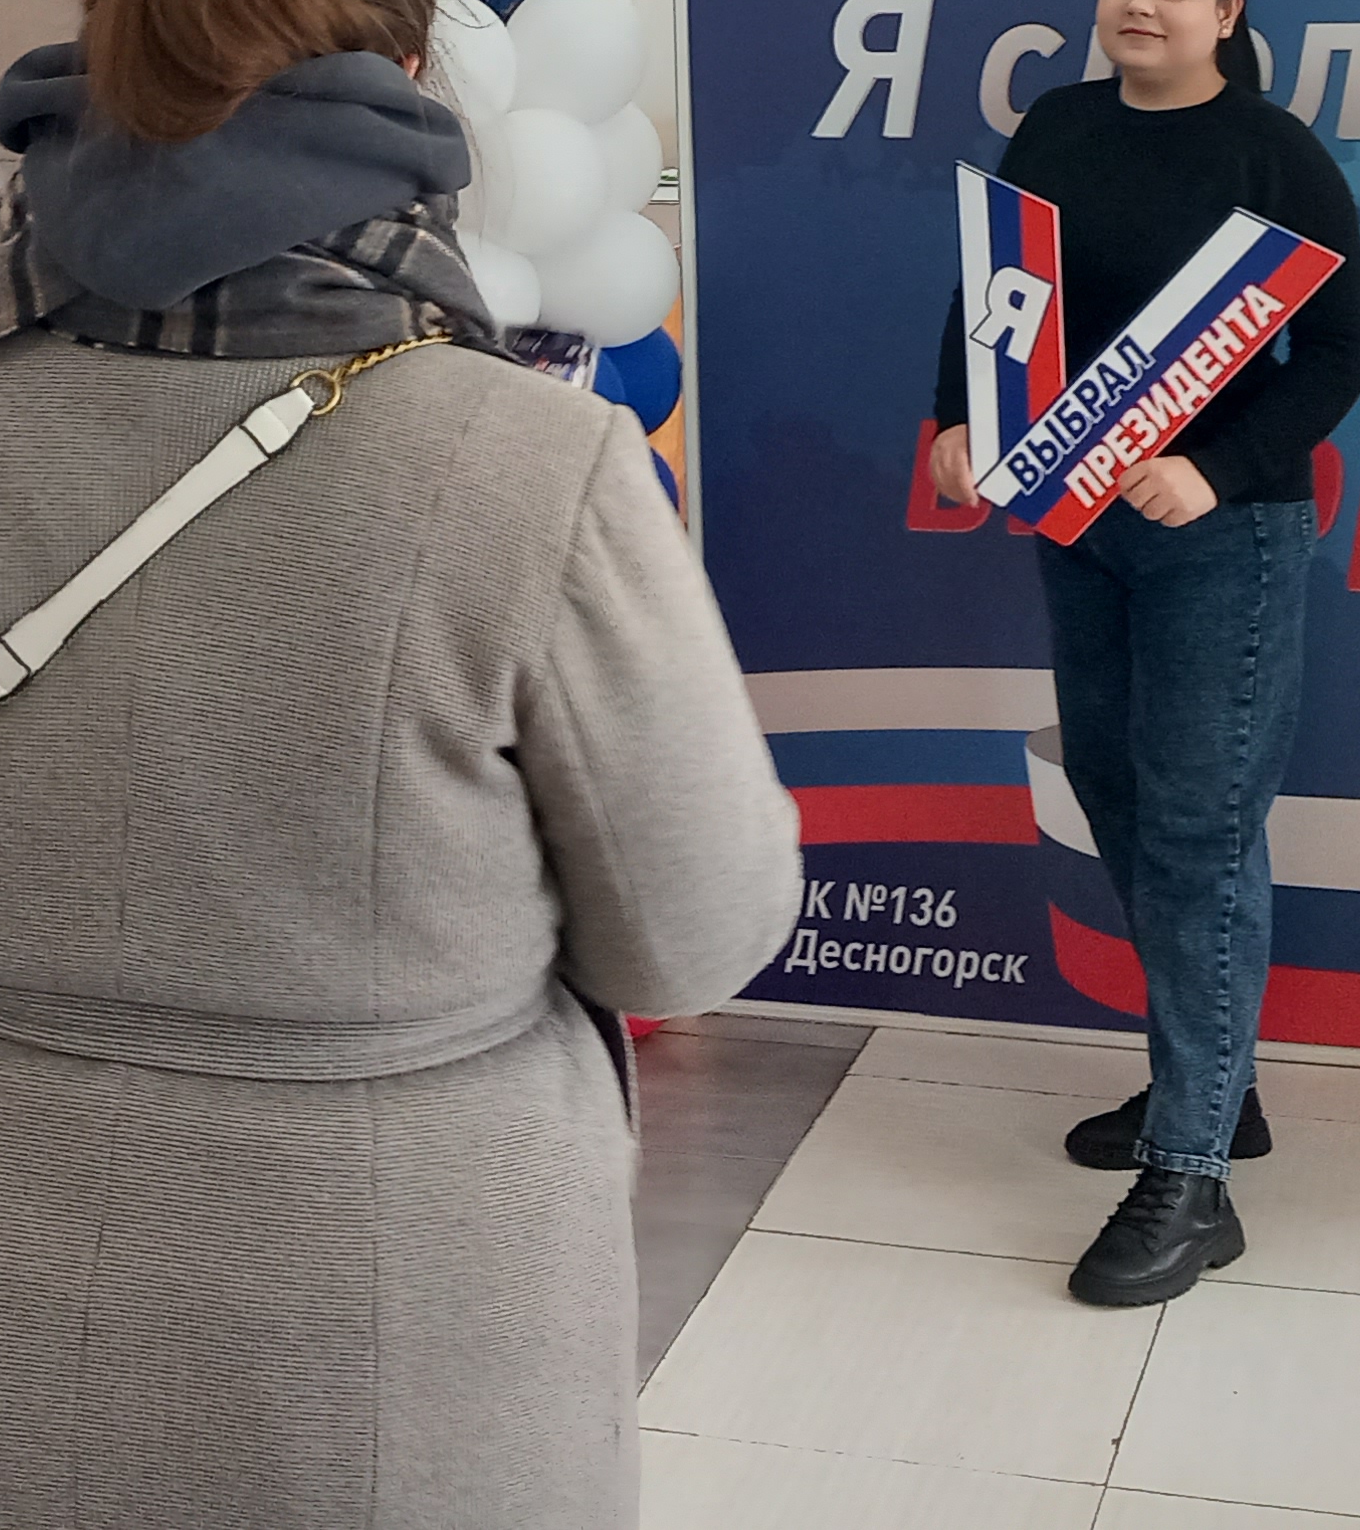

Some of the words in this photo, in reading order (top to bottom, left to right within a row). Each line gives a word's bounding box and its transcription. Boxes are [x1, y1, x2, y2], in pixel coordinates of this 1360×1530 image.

[969, 266, 1055, 365] Я
[1005, 334, 1156, 497] ВЫБРАЛ
[1063, 283, 1287, 509] ПРЕЗИДЕНТА
[843, 881, 958, 929] №136
[783, 927, 1029, 989] Десногорск
